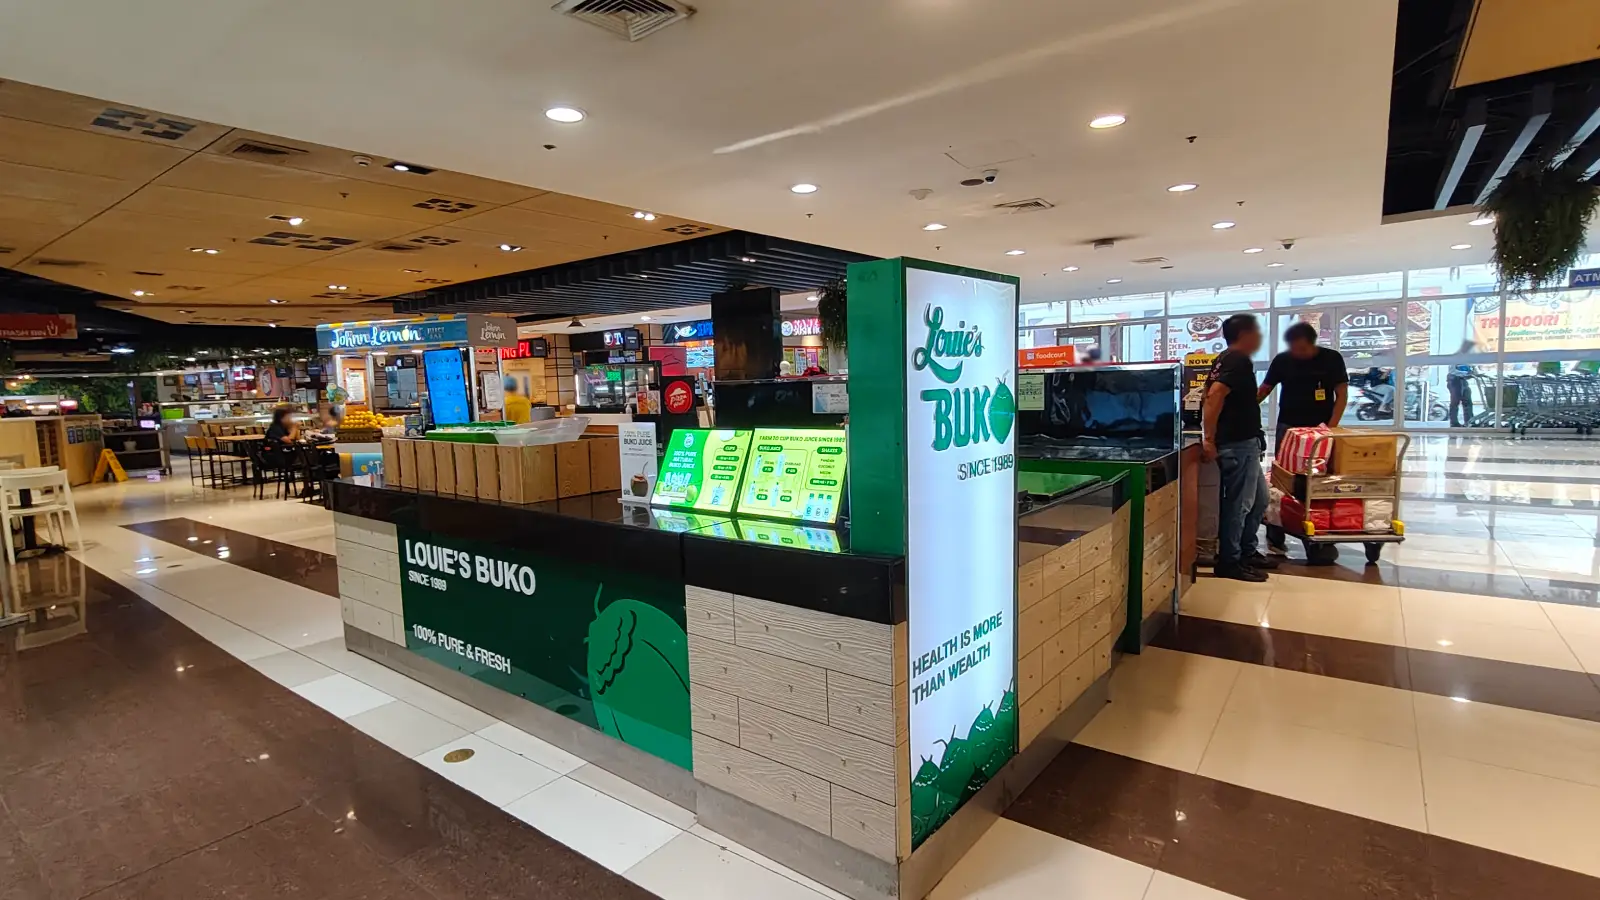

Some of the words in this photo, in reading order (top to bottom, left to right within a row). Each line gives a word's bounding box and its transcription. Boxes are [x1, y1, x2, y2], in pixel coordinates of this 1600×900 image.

[1573, 272, 1600, 283] ATM
[370, 326, 421, 346] Lemon
[911, 303, 985, 384] Louie's
[1036, 351, 1067, 359] foodcourt
[920, 376, 1015, 451] BUKO
[638, 438, 652, 446] JUICE
[958, 458, 990, 480] SINCE
[991, 454, 1014, 472] 1989
[405, 539, 471, 579] LOUIE'S
[476, 555, 536, 595] BUKO
[408, 570, 430, 586] SINCE
[430, 576, 447, 592] 1989
[412, 624, 437, 645] 100%
[438, 632, 465, 656] PURE
[466, 644, 474, 660] &
[475, 647, 511, 674] FRESH
[912, 637, 958, 678] HEALTH
[960, 630, 971, 649] IS
[973, 611, 1003, 640] MORE
[912, 669, 946, 705] THAN
[948, 642, 991, 682] WEALTH
